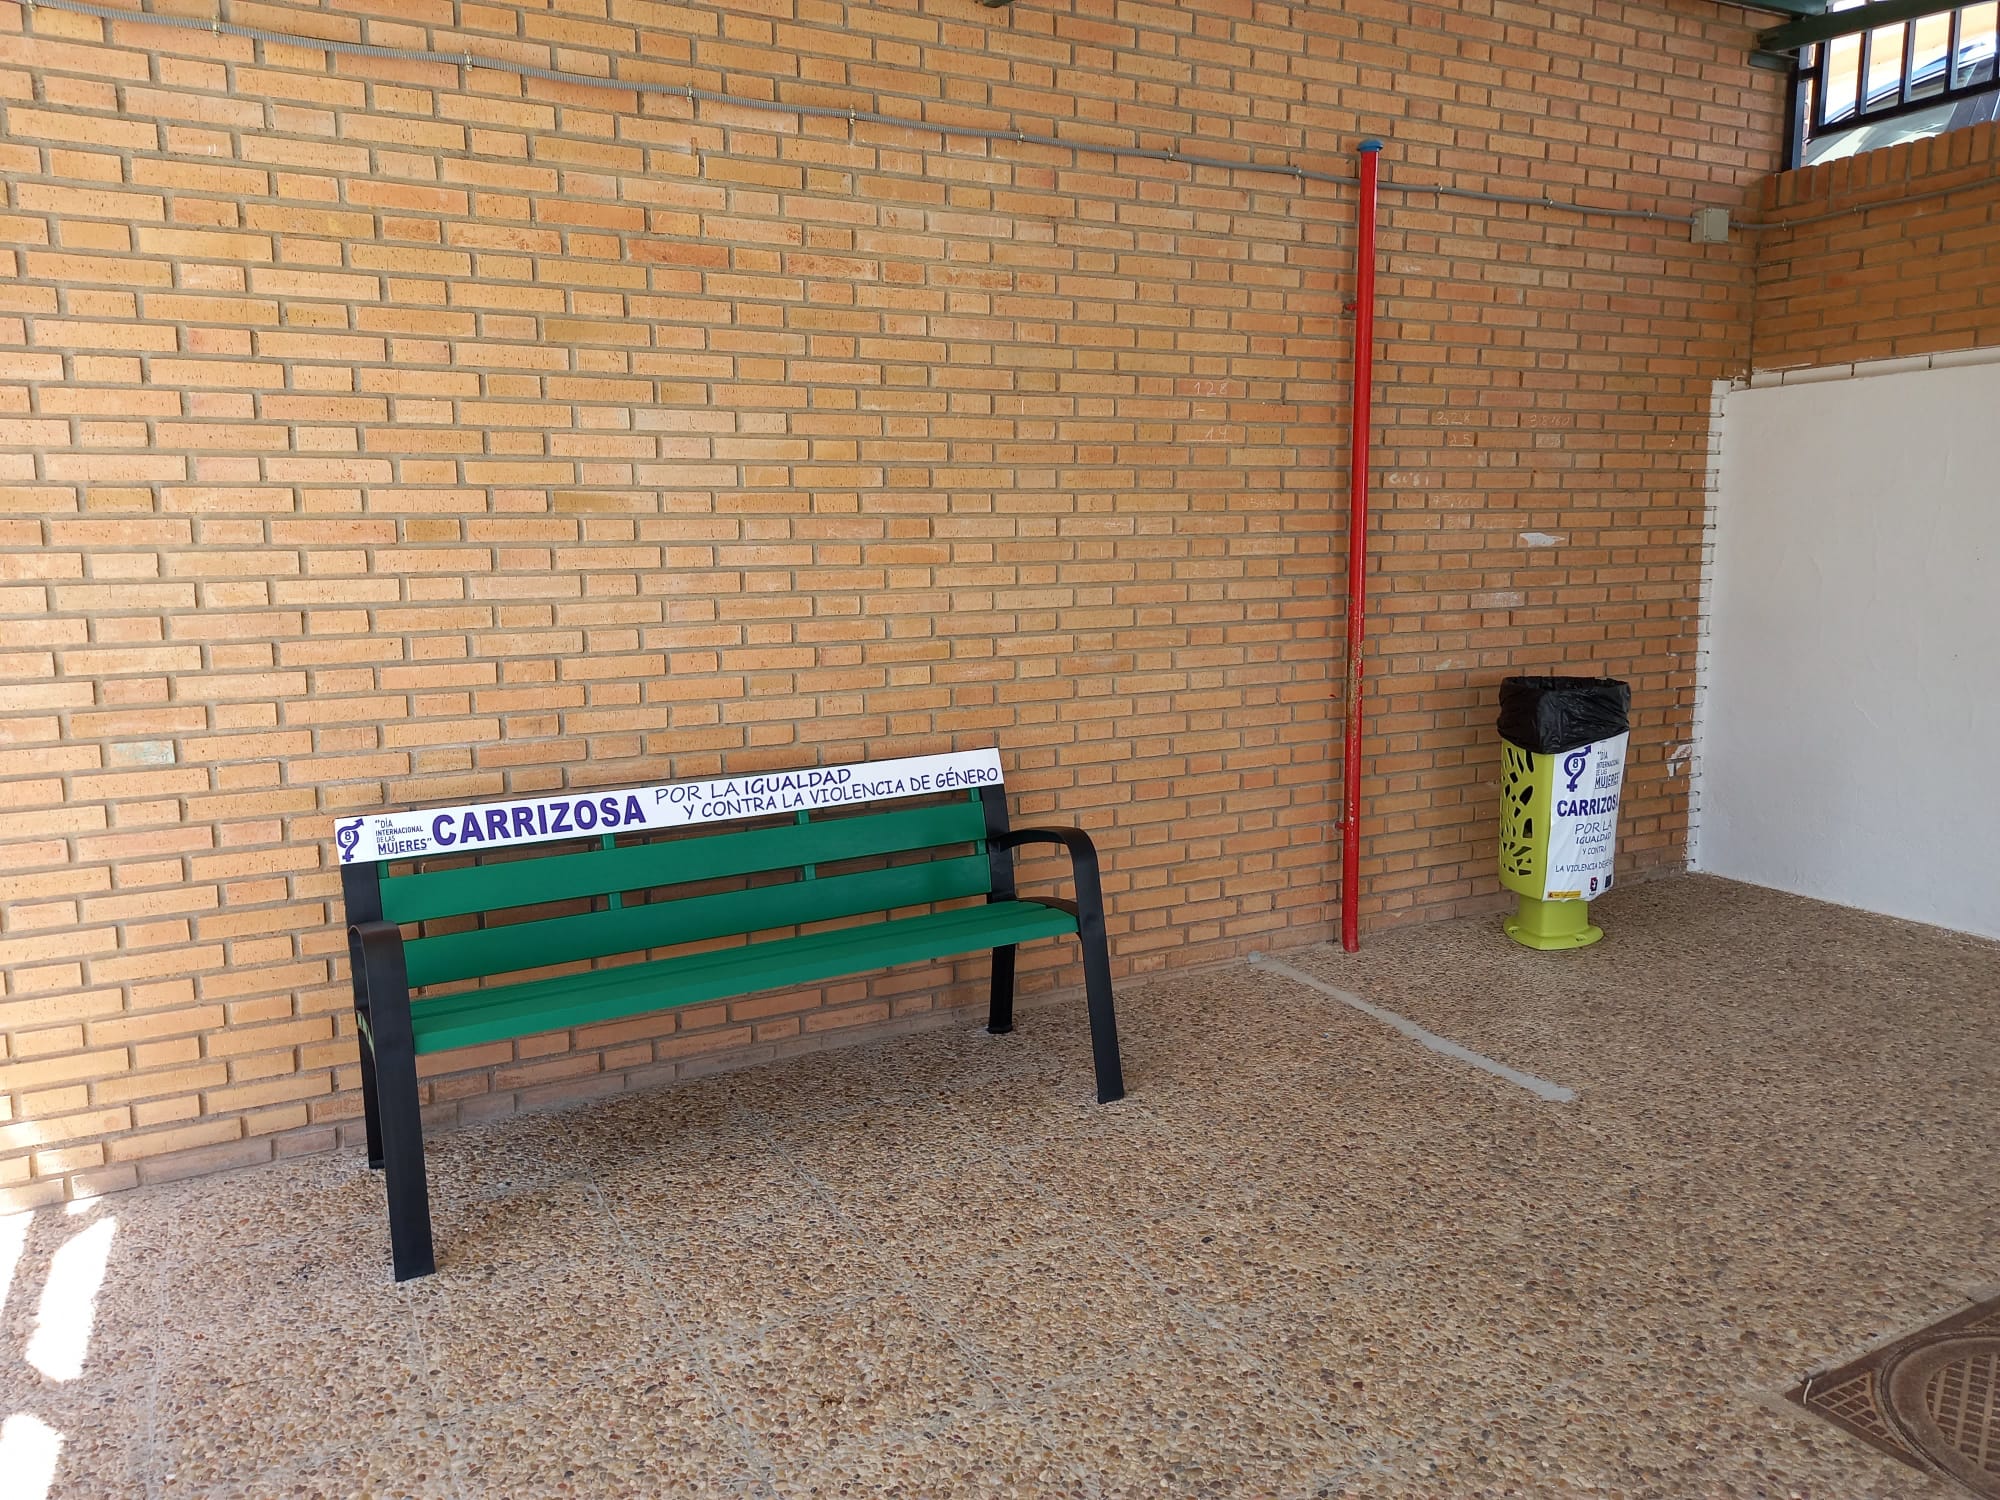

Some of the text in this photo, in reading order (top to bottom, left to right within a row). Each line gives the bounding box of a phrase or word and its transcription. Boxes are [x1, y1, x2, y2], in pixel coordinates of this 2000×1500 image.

[1572, 758, 1579, 769] 8
[655, 768, 852, 805] POR LA IGUALDAD
[683, 766, 998, 820] Y CONTRA LA VIOLENCIA DE GÉNERO
[431, 795, 647, 847] CARRIZOSA
[1575, 819, 1613, 835] POR LA
[344, 830, 352, 841] 8
[375, 825, 424, 837] INTERNACIONAL
[1576, 831, 1612, 845] IGUALDAD
[1555, 864, 1565, 873] LA
